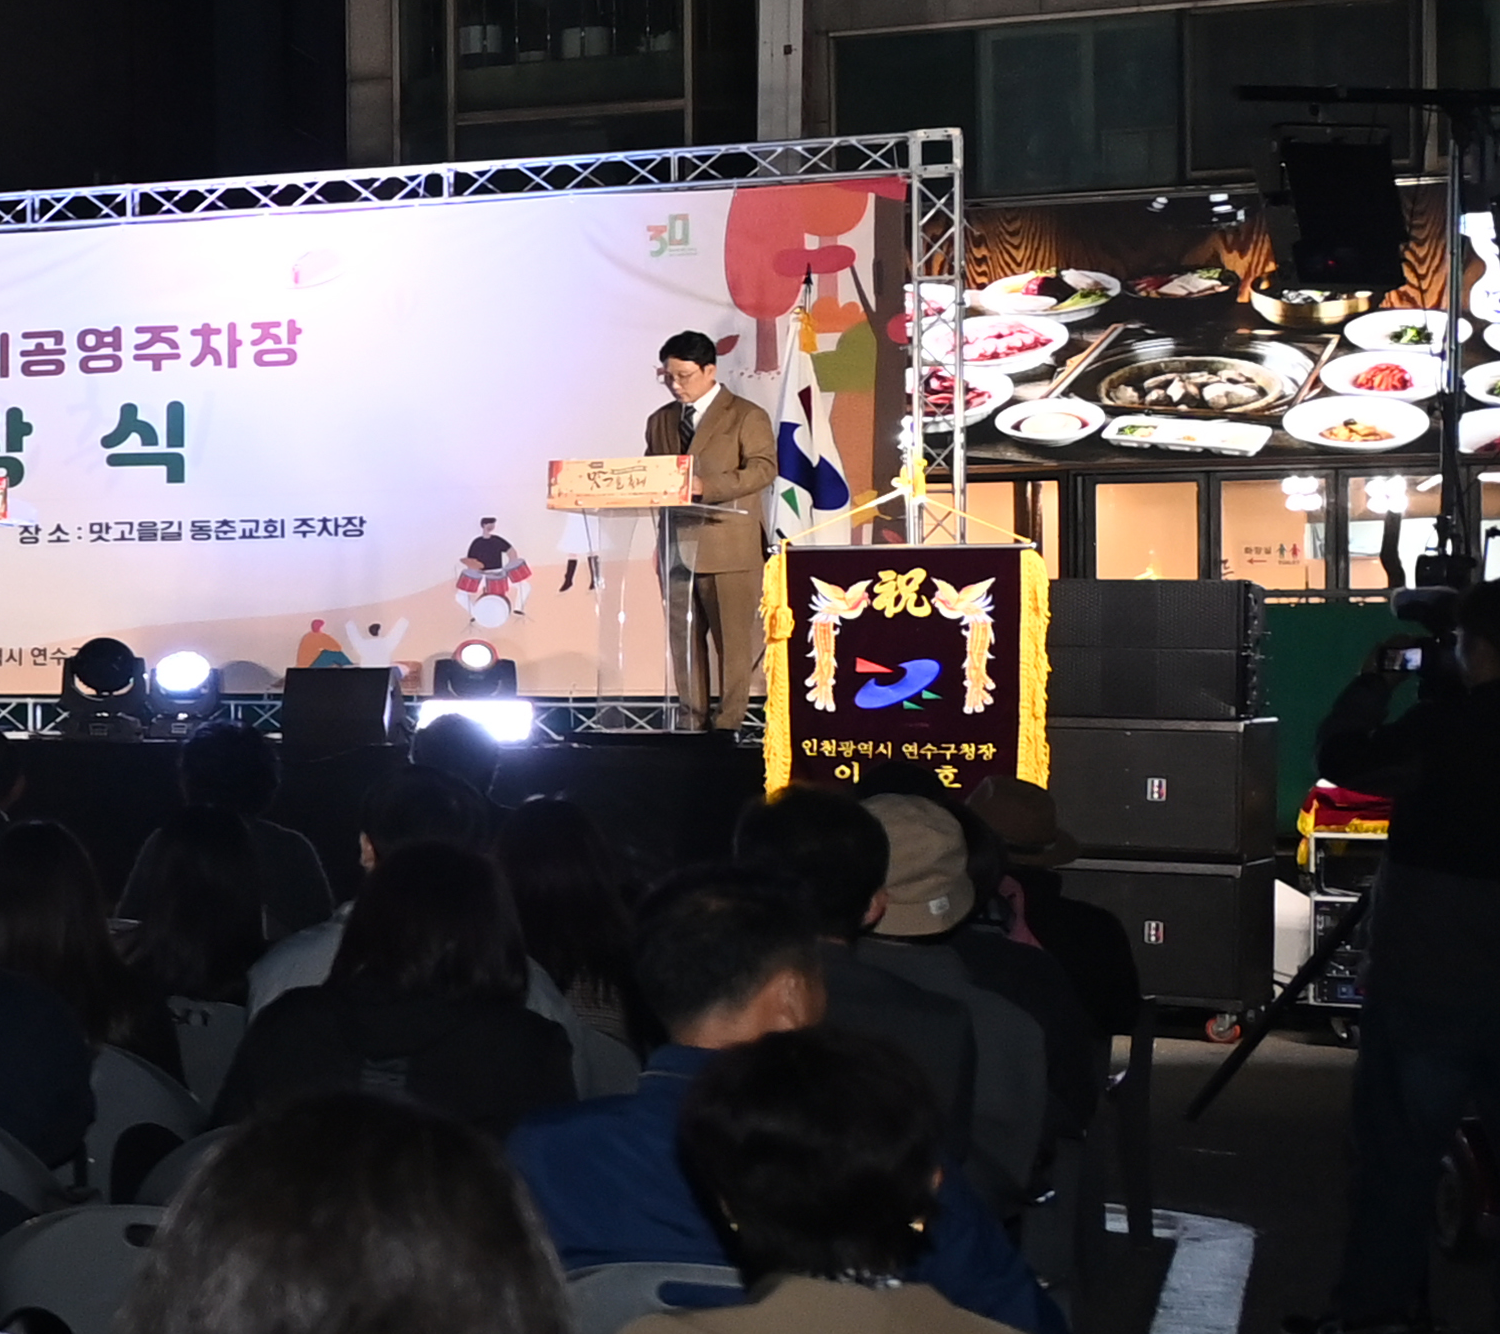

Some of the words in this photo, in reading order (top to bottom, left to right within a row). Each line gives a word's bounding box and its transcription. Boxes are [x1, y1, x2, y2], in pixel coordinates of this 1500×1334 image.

[88, 521, 184, 544] 맛고을길
[189, 518, 286, 542] 동춘교회
[292, 516, 367, 539] 주차장
[872, 567, 932, 618] 祝
[801, 739, 893, 760] 인천광역시
[901, 742, 997, 761] 연수구청장
